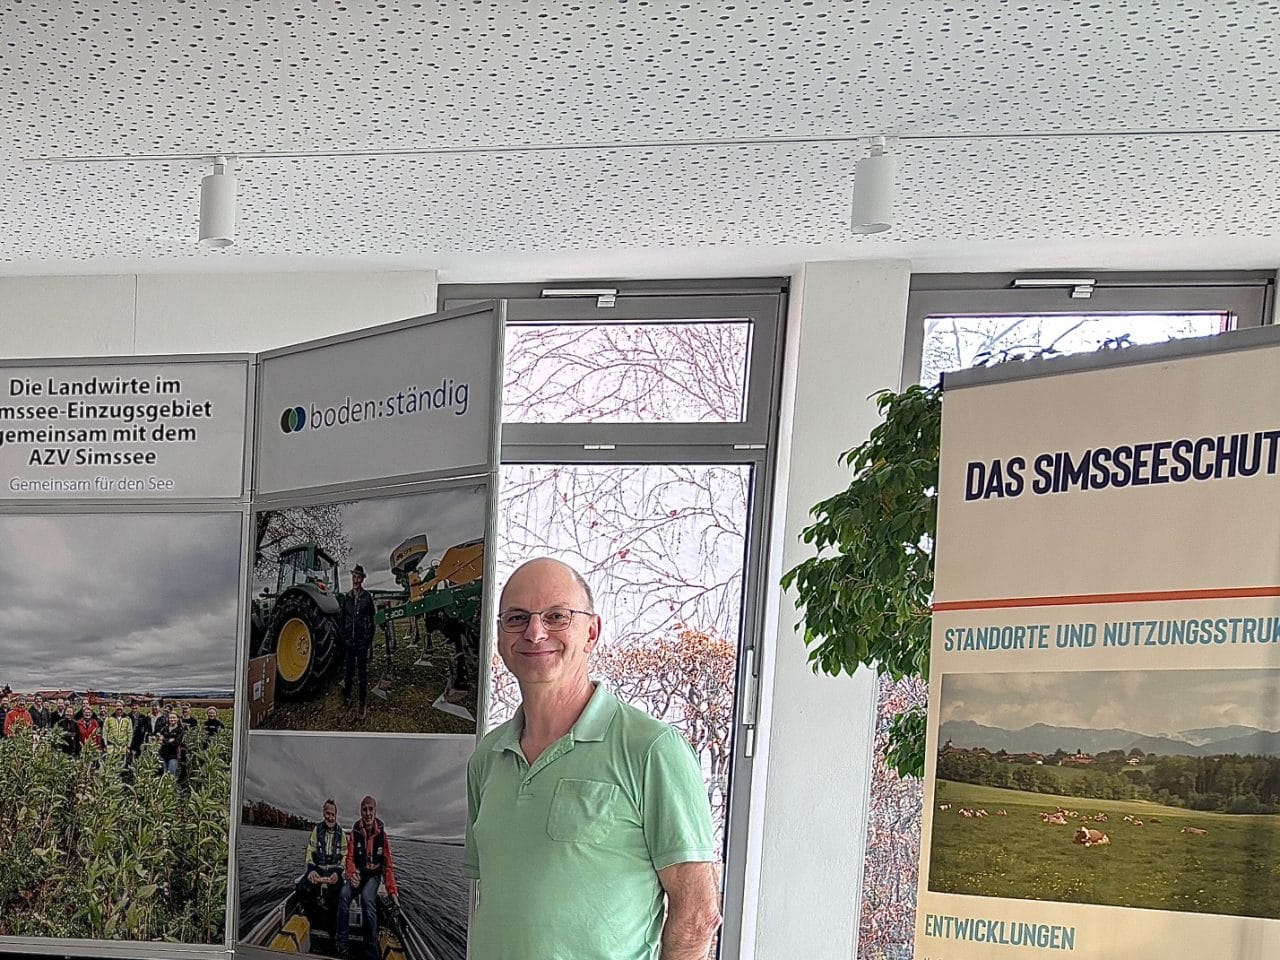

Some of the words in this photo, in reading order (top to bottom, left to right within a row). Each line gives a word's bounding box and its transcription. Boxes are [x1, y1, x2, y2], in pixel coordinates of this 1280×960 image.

[10, 378, 42, 396] Die
[48, 377, 150, 395] Landwirte
[156, 376, 181, 394] im
[310, 379, 469, 416] boden:ständig
[113, 425, 147, 442] mit
[152, 424, 196, 441] dem
[29, 449, 70, 465] AZV
[75, 449, 156, 465] Simssee
[9, 477, 90, 491] Gemeinsam
[95, 476, 114, 491] für
[118, 476, 144, 490] den
[148, 476, 173, 490] See
[966, 456, 1025, 501] DAS
[944, 624, 1050, 652] STANDORTE
[1056, 623, 1096, 648] UND
[925, 914, 1075, 950] ENTWICKLUNGEN
